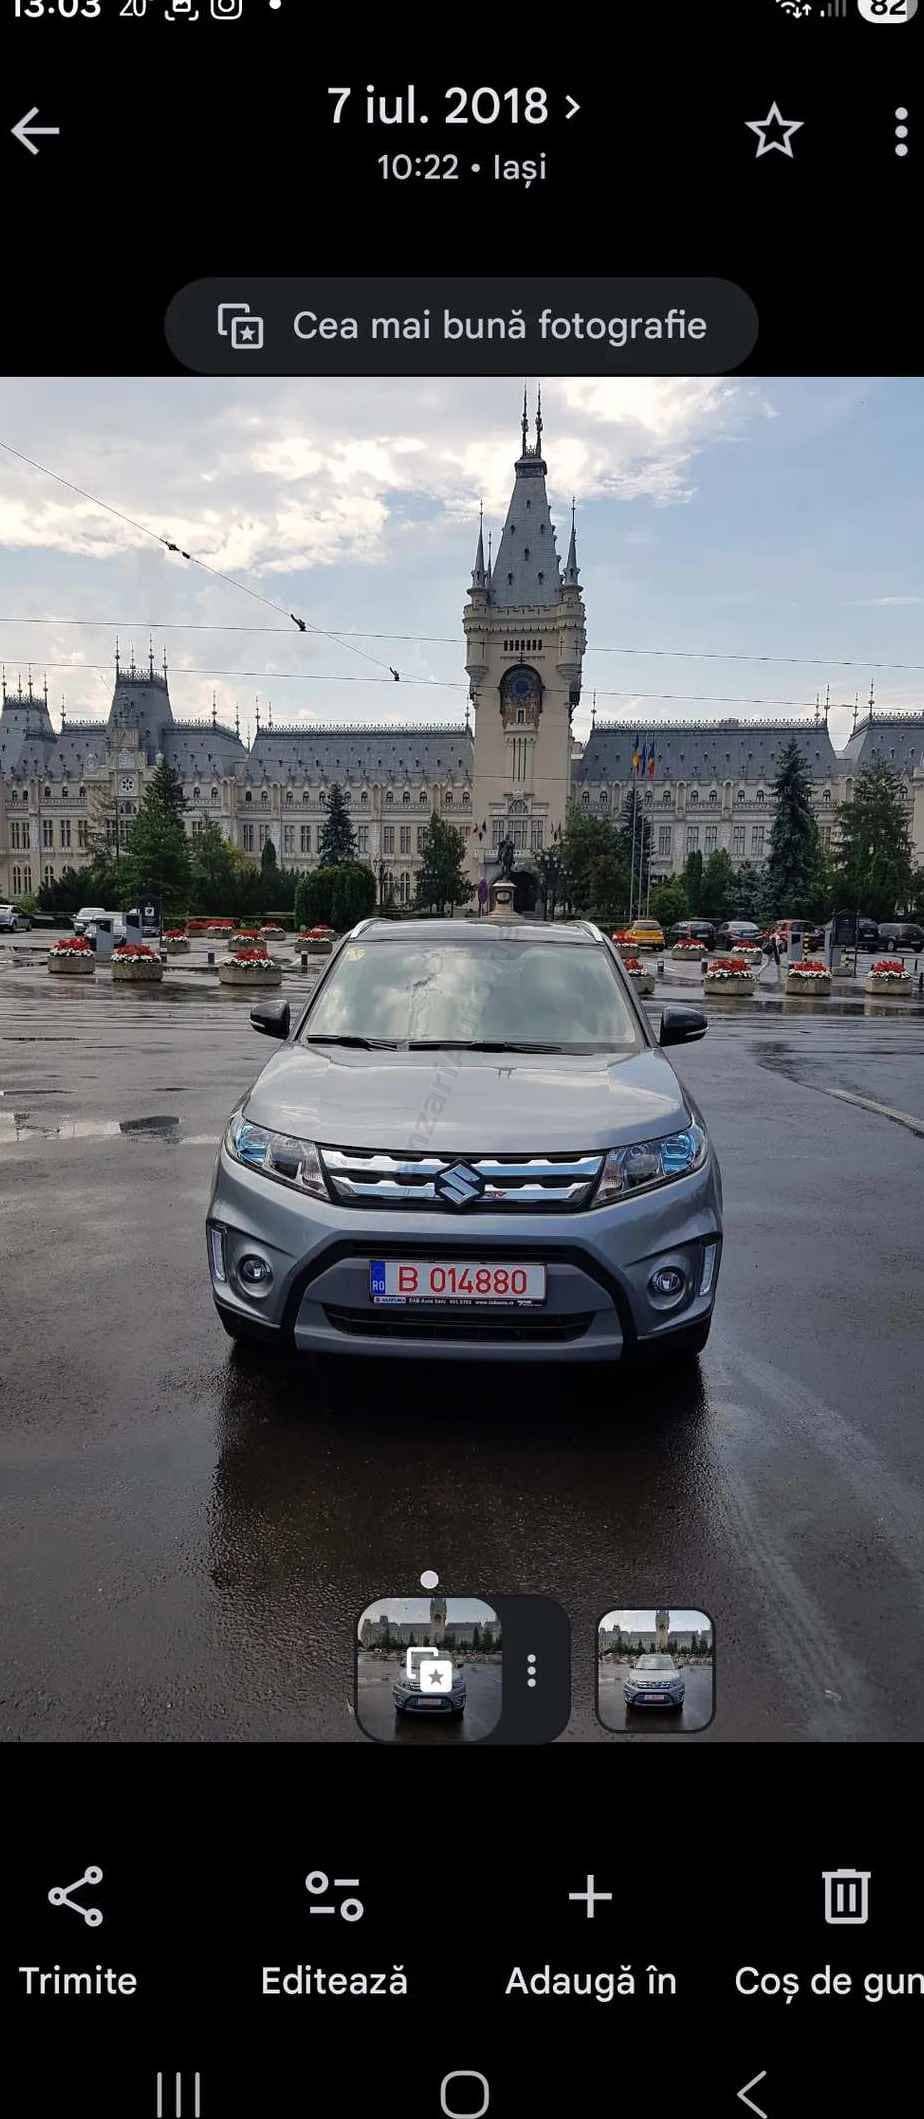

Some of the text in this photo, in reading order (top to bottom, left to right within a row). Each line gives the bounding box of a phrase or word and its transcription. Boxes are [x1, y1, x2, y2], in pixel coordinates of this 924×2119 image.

[119, 0, 154, 17] 20
[327, 85, 548, 125] 7 iul. 2018
[377, 153, 546, 189] 10:22 Iași
[293, 309, 707, 348] Cea mai bună fotografie
[372, 1266, 527, 1295] RO B 014880
[18, 1965, 137, 1995] Trimite
[262, 1964, 408, 1995] Editează
[504, 1964, 677, 2003] Adaugă în
[735, 1964, 924, 2005] Coș de gun
